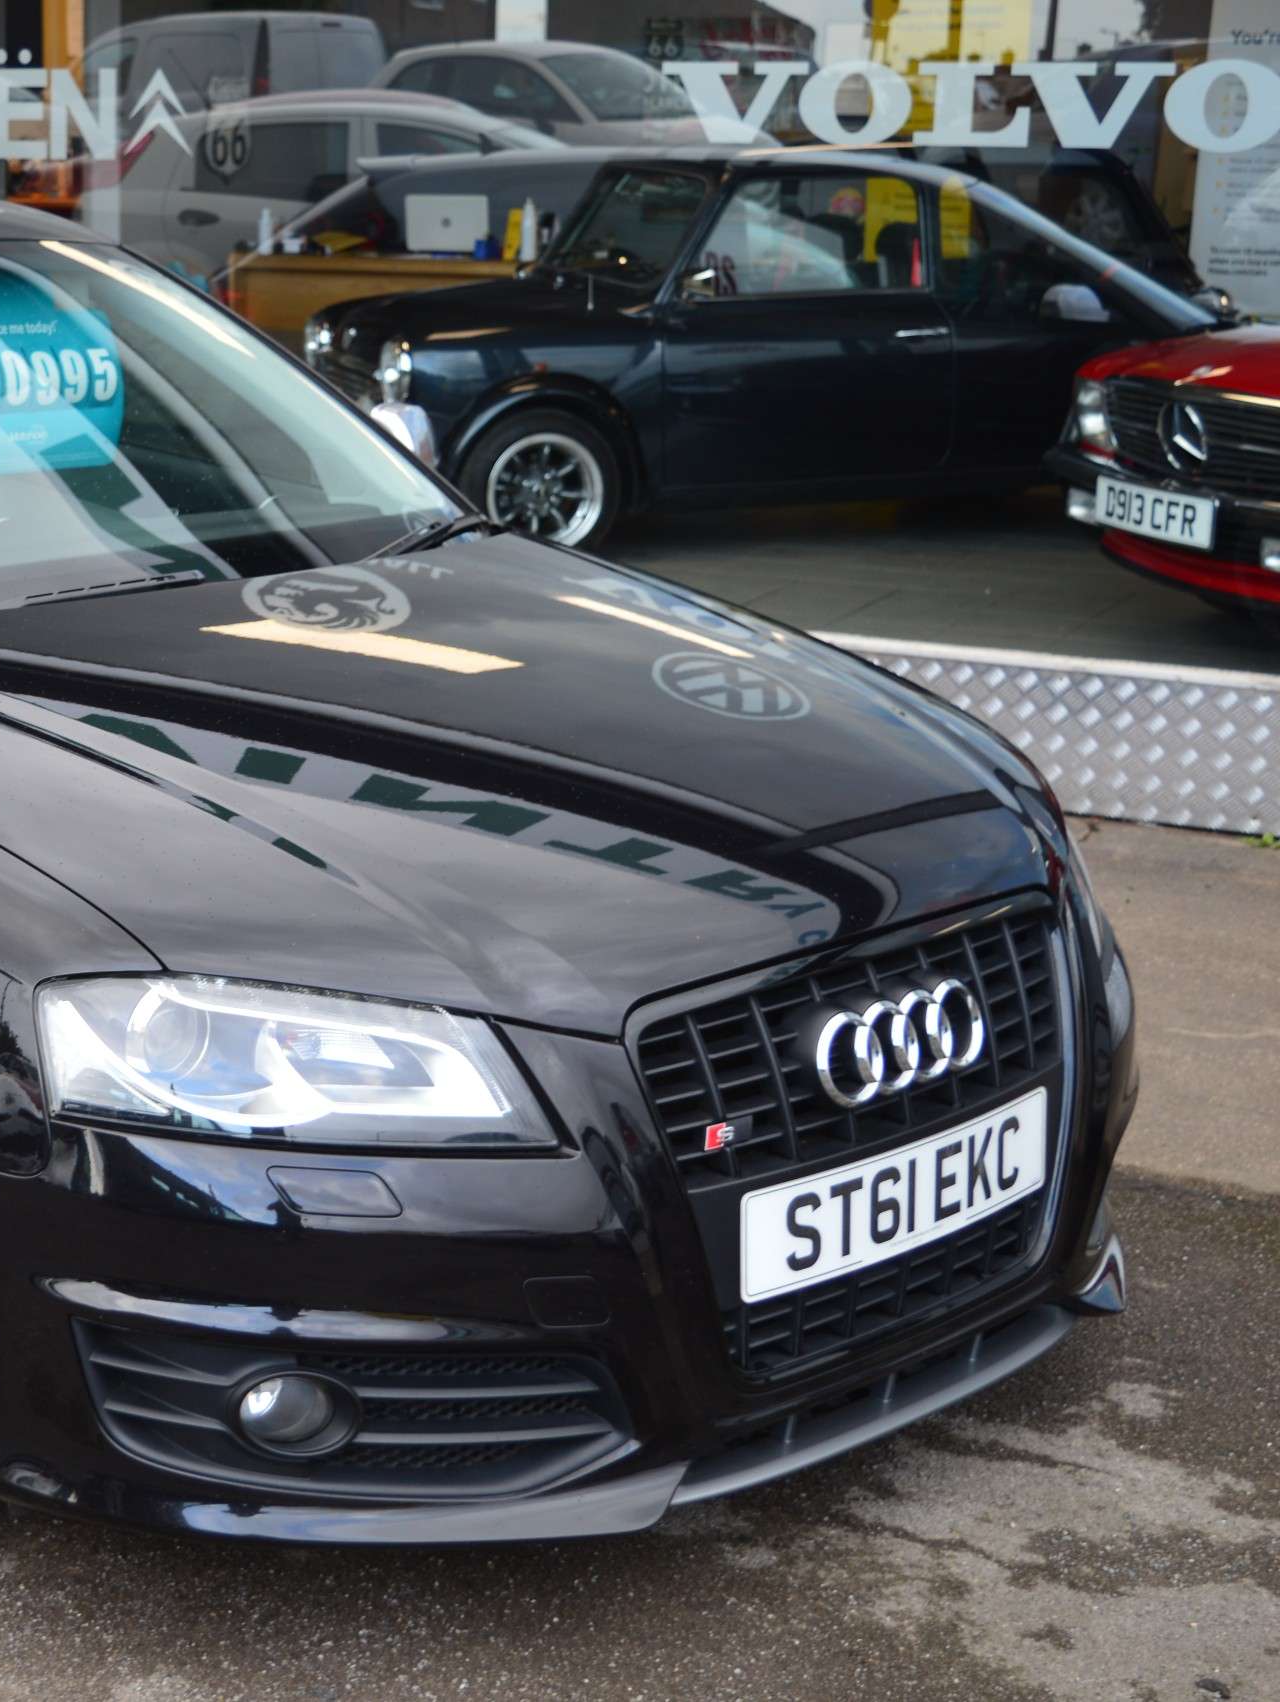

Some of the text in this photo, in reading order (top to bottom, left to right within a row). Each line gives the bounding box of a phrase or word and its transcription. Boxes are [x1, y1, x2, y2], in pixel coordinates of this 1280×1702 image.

[662, 58, 1280, 152] VOLVO
[1106, 486, 1196, 538] D913 CFR
[786, 1115, 1020, 1272] ST61 EKC
